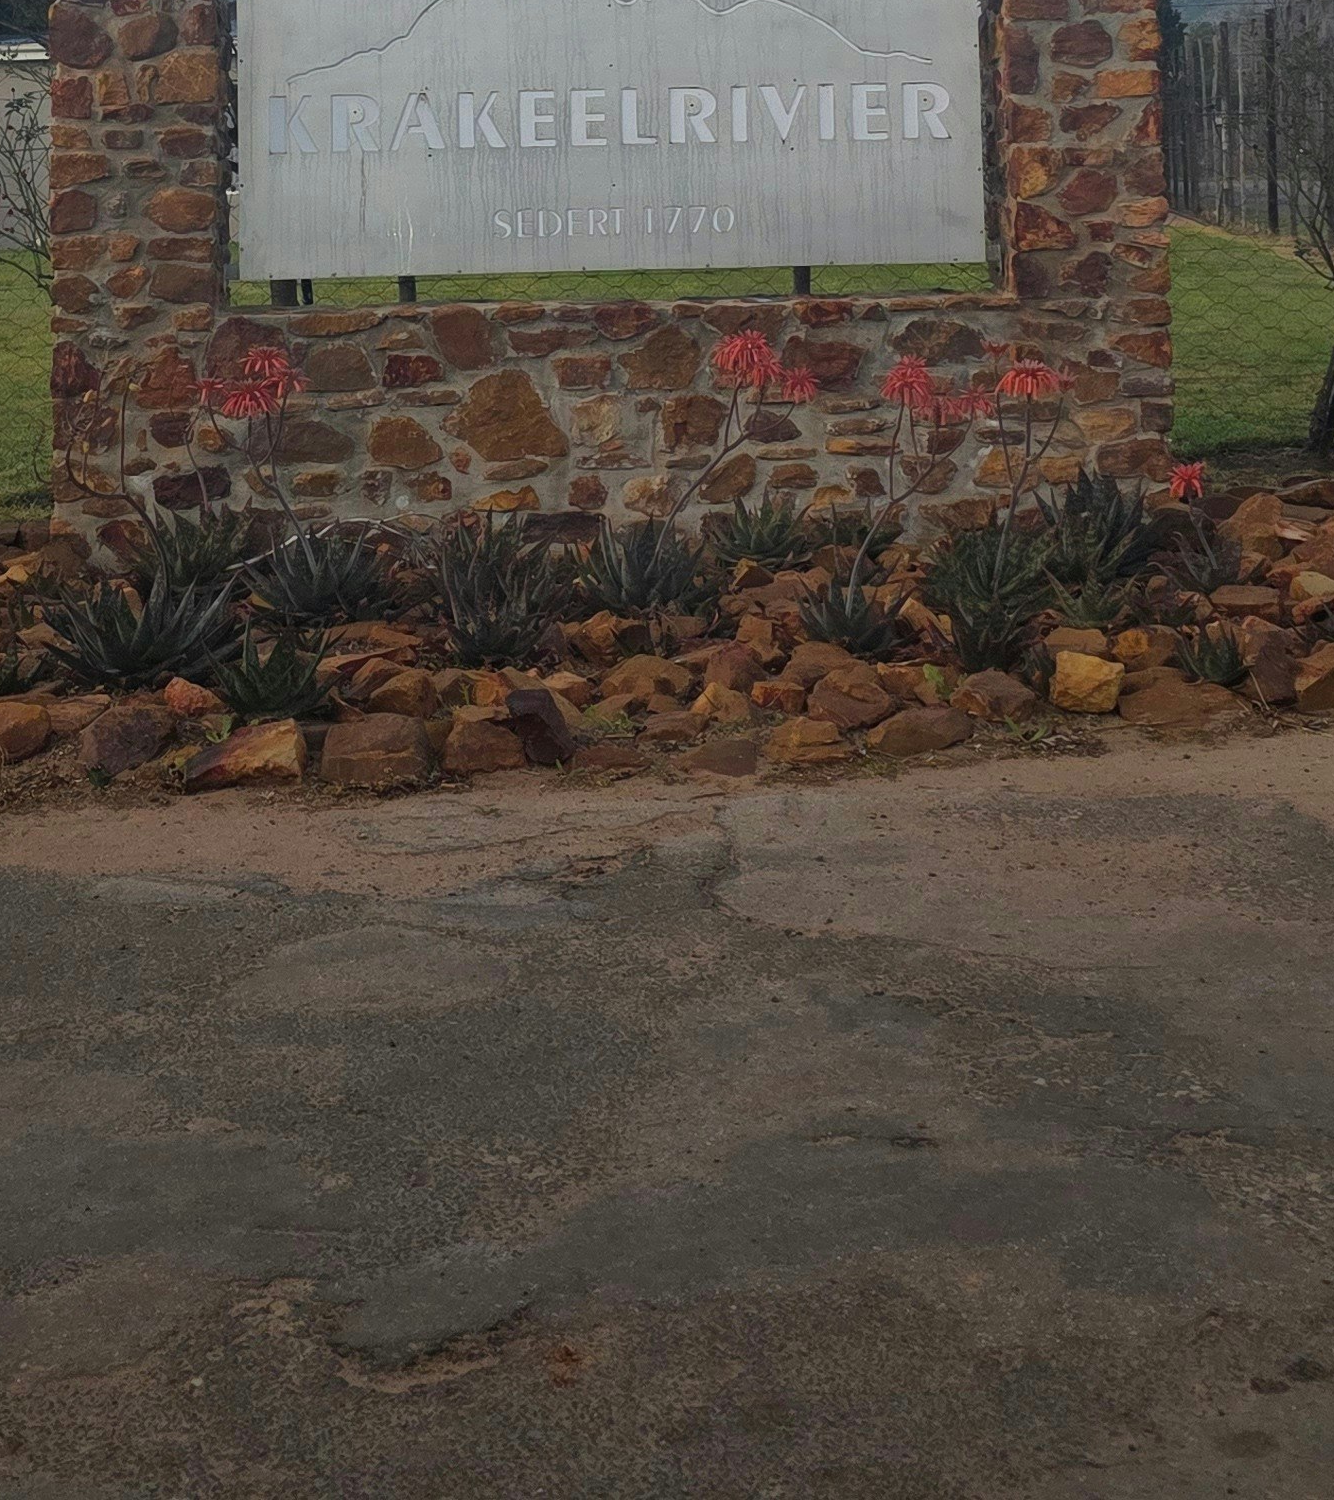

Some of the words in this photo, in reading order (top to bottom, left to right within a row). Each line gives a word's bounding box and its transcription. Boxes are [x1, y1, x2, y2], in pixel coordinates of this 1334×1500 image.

[268, 82, 952, 155] KRAKEELRIVIER
[493, 207, 625, 238] SEDERT
[644, 204, 735, 234] 1770
